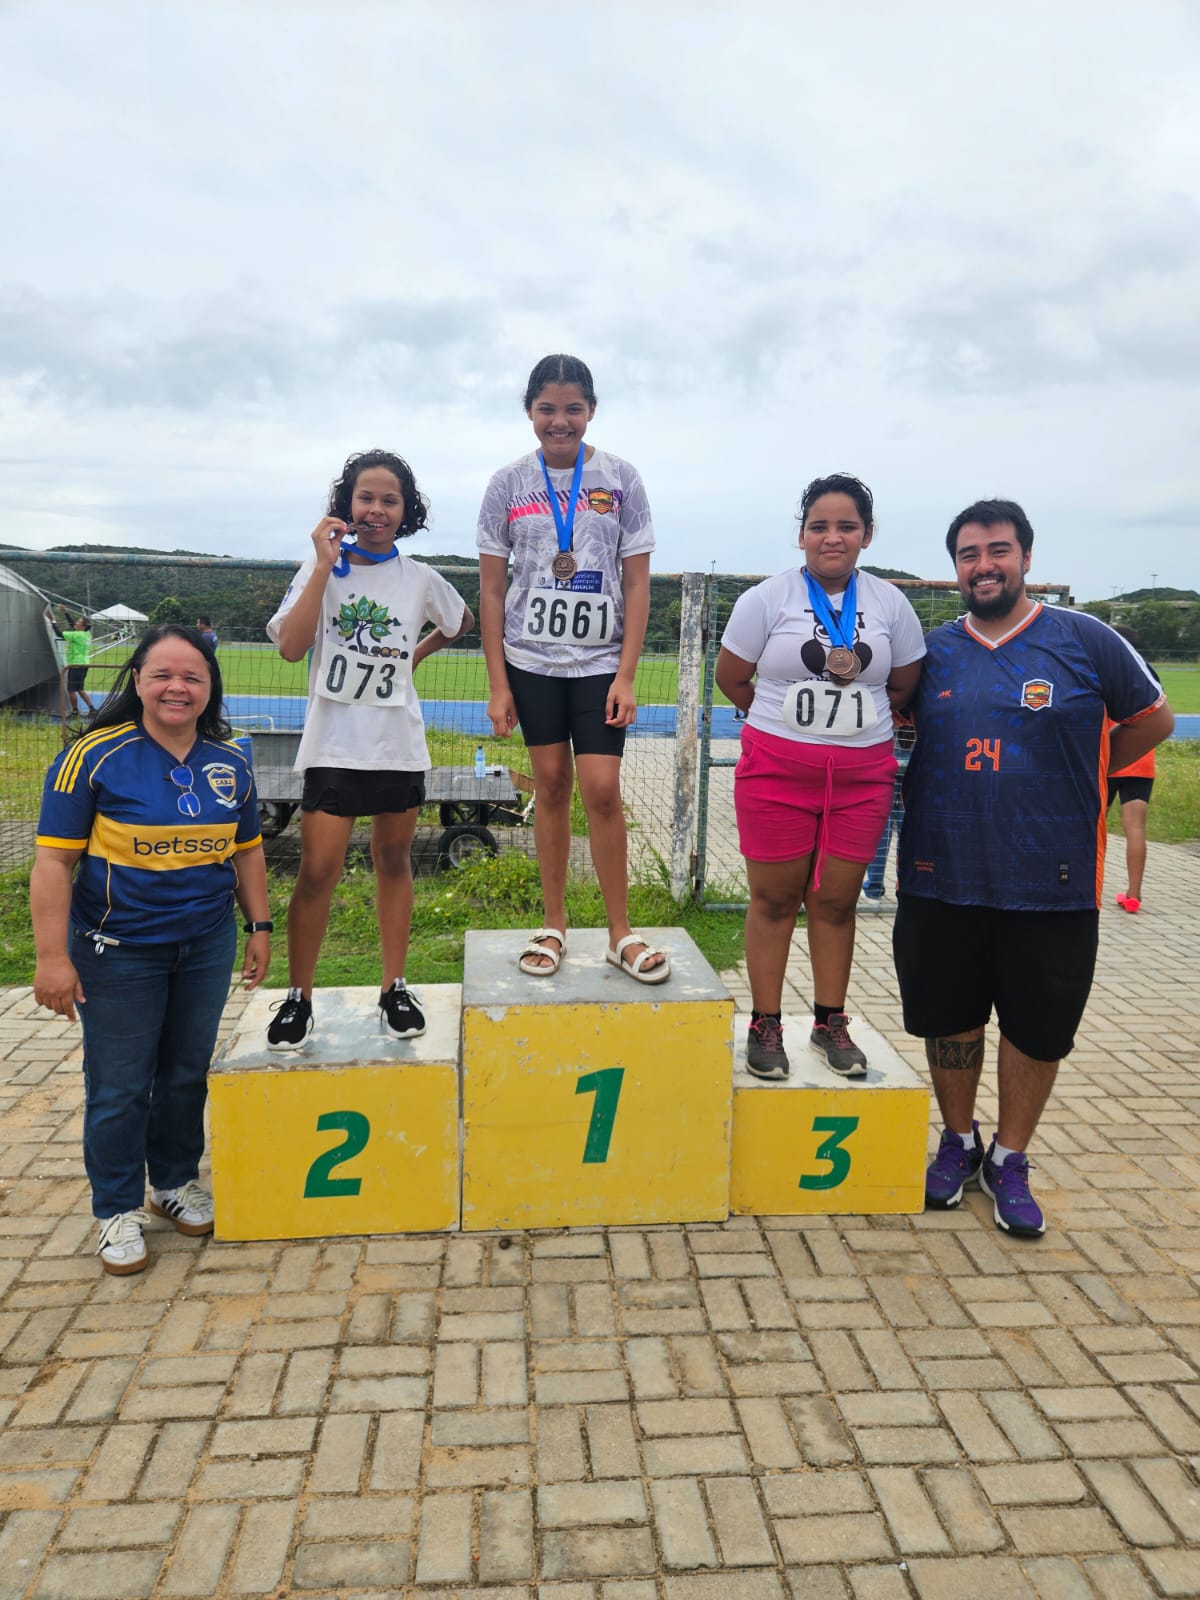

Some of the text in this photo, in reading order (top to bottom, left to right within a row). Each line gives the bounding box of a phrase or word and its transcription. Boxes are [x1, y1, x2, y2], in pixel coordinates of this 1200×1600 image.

[528, 596, 608, 640] 3661
[326, 653, 396, 700] 073
[795, 687, 864, 729] 071
[965, 738, 1001, 772] 24
[574, 1067, 625, 1164] 1
[303, 1110, 371, 1199] 2
[798, 1116, 860, 1192] 3
